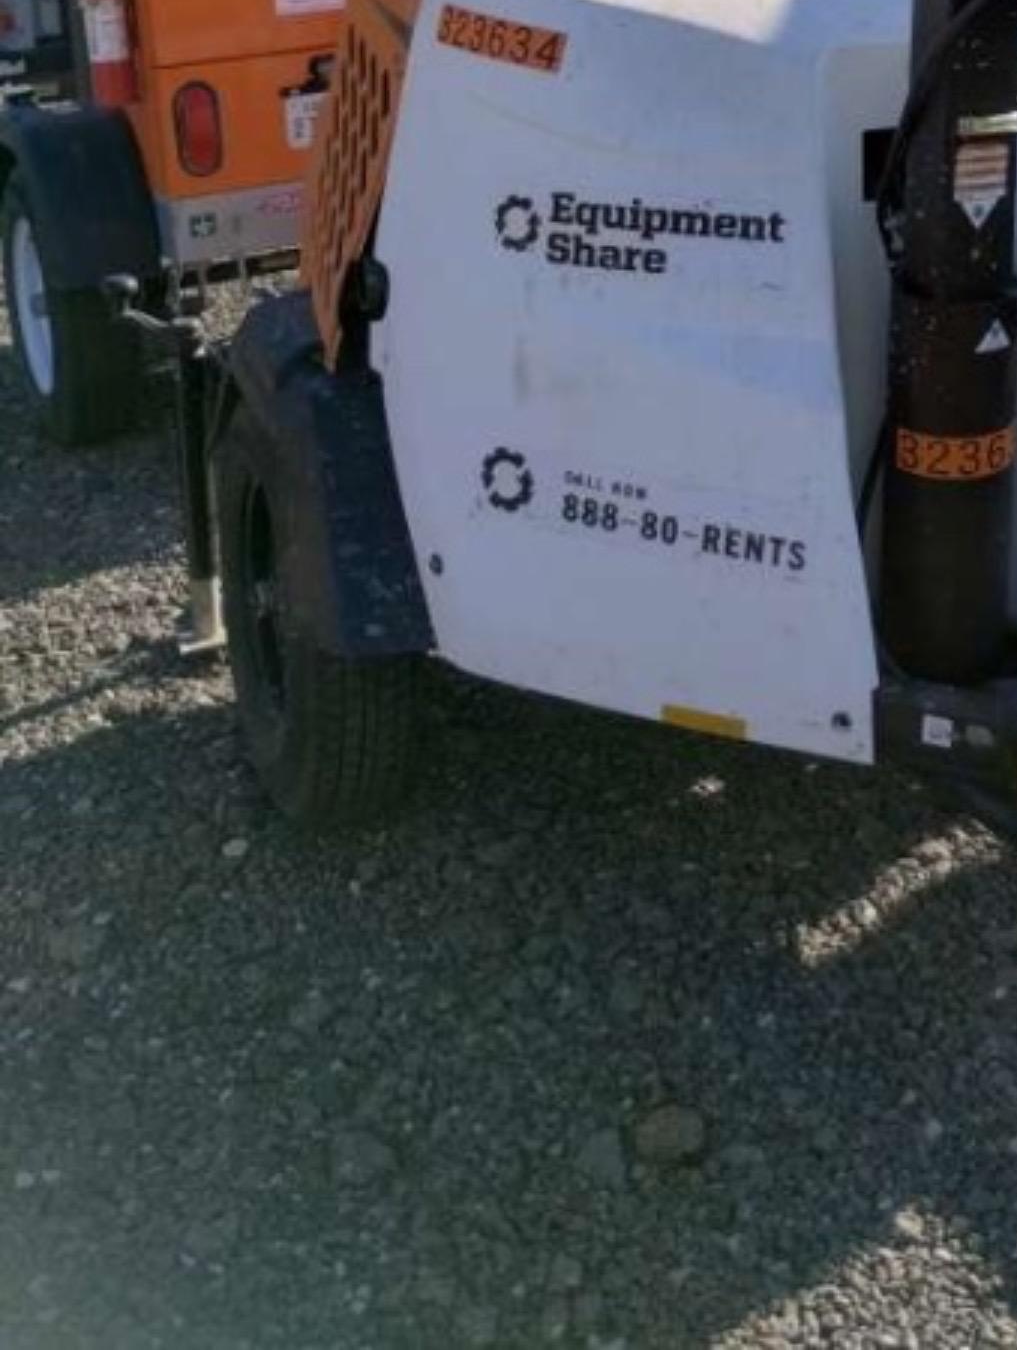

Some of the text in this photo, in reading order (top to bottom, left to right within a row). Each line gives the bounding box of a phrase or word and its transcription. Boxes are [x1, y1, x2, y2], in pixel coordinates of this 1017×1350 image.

[439, 5, 561, 70] 323634
[549, 192, 785, 243] Equipment
[546, 233, 667, 274] Share
[562, 493, 806, 571] 888-80-RENTS
